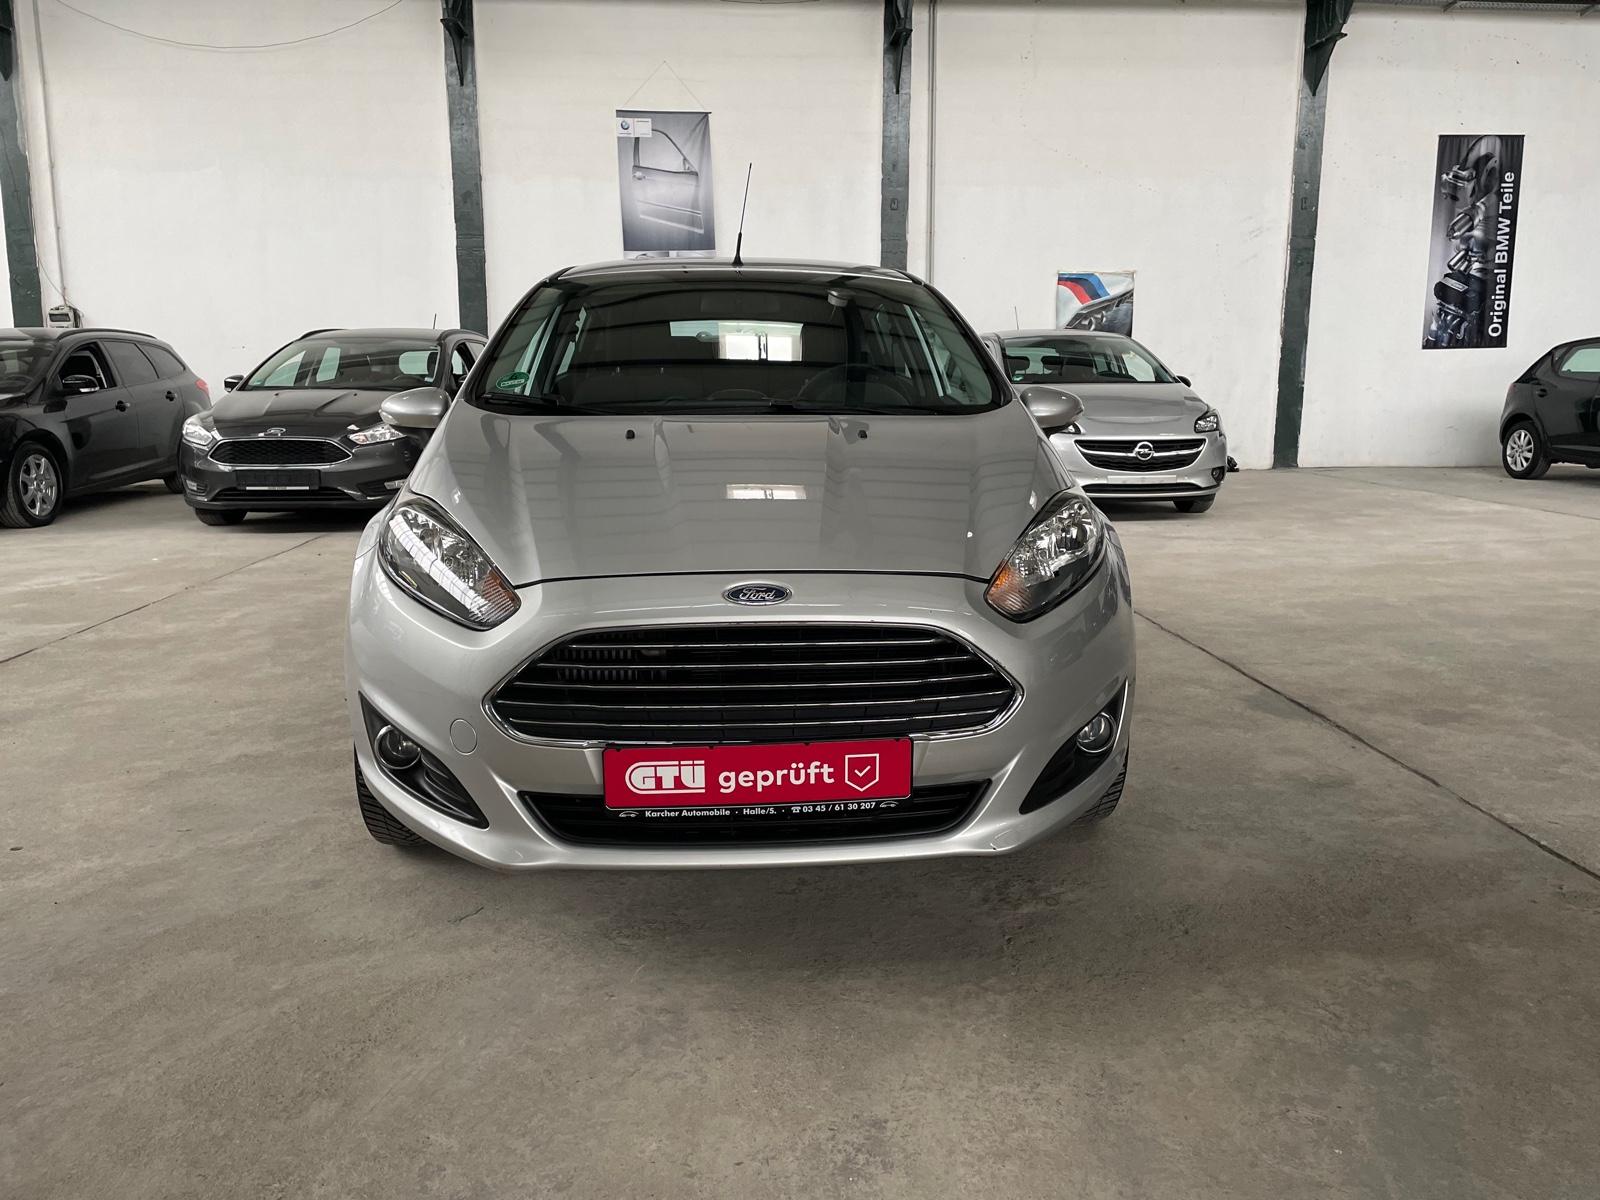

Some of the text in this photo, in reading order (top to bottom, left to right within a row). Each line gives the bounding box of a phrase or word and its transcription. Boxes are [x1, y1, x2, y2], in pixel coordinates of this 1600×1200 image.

[1488, 172, 1515, 338] Original BMW Teile
[739, 587, 776, 600] Ford
[625, 760, 835, 794] GTÜ geprüft
[645, 809, 679, 817] Karcher
[681, 808, 731, 817] Automobile
[802, 805, 814, 813] 03
[815, 804, 826, 812] 45
[834, 803, 844, 811] 61
[847, 802, 858, 810] 30
[860, 801, 876, 809] 207
